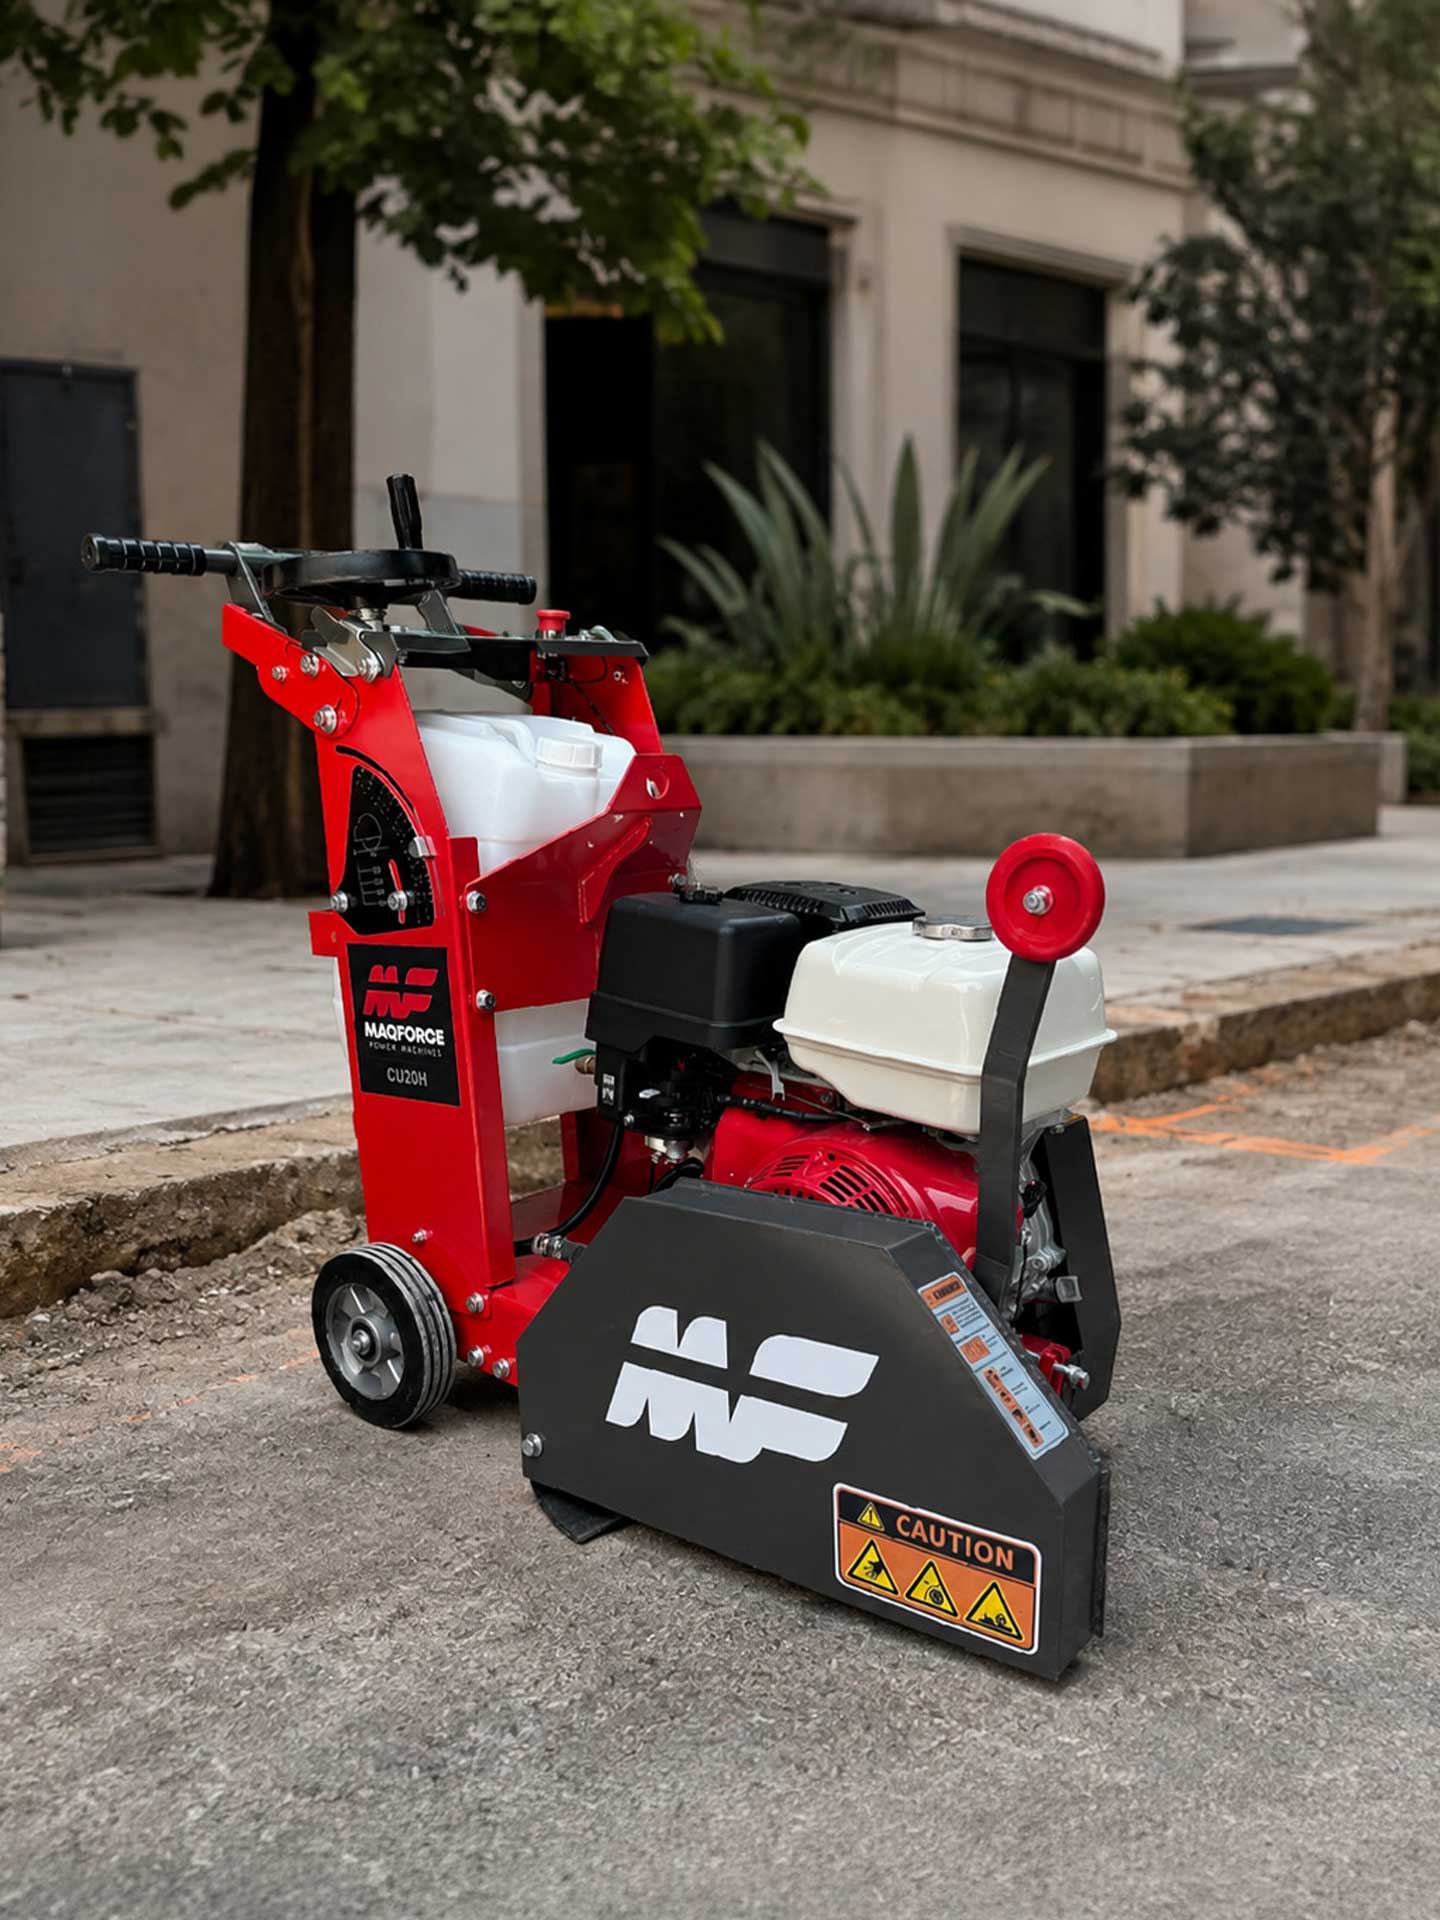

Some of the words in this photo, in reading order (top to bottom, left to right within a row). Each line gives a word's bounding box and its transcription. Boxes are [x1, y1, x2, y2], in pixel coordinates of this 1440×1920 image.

[364, 1021, 445, 1046] MAQFORCE
[387, 1067, 428, 1087] CU20H
[896, 1514, 1014, 1570] CAUTION
